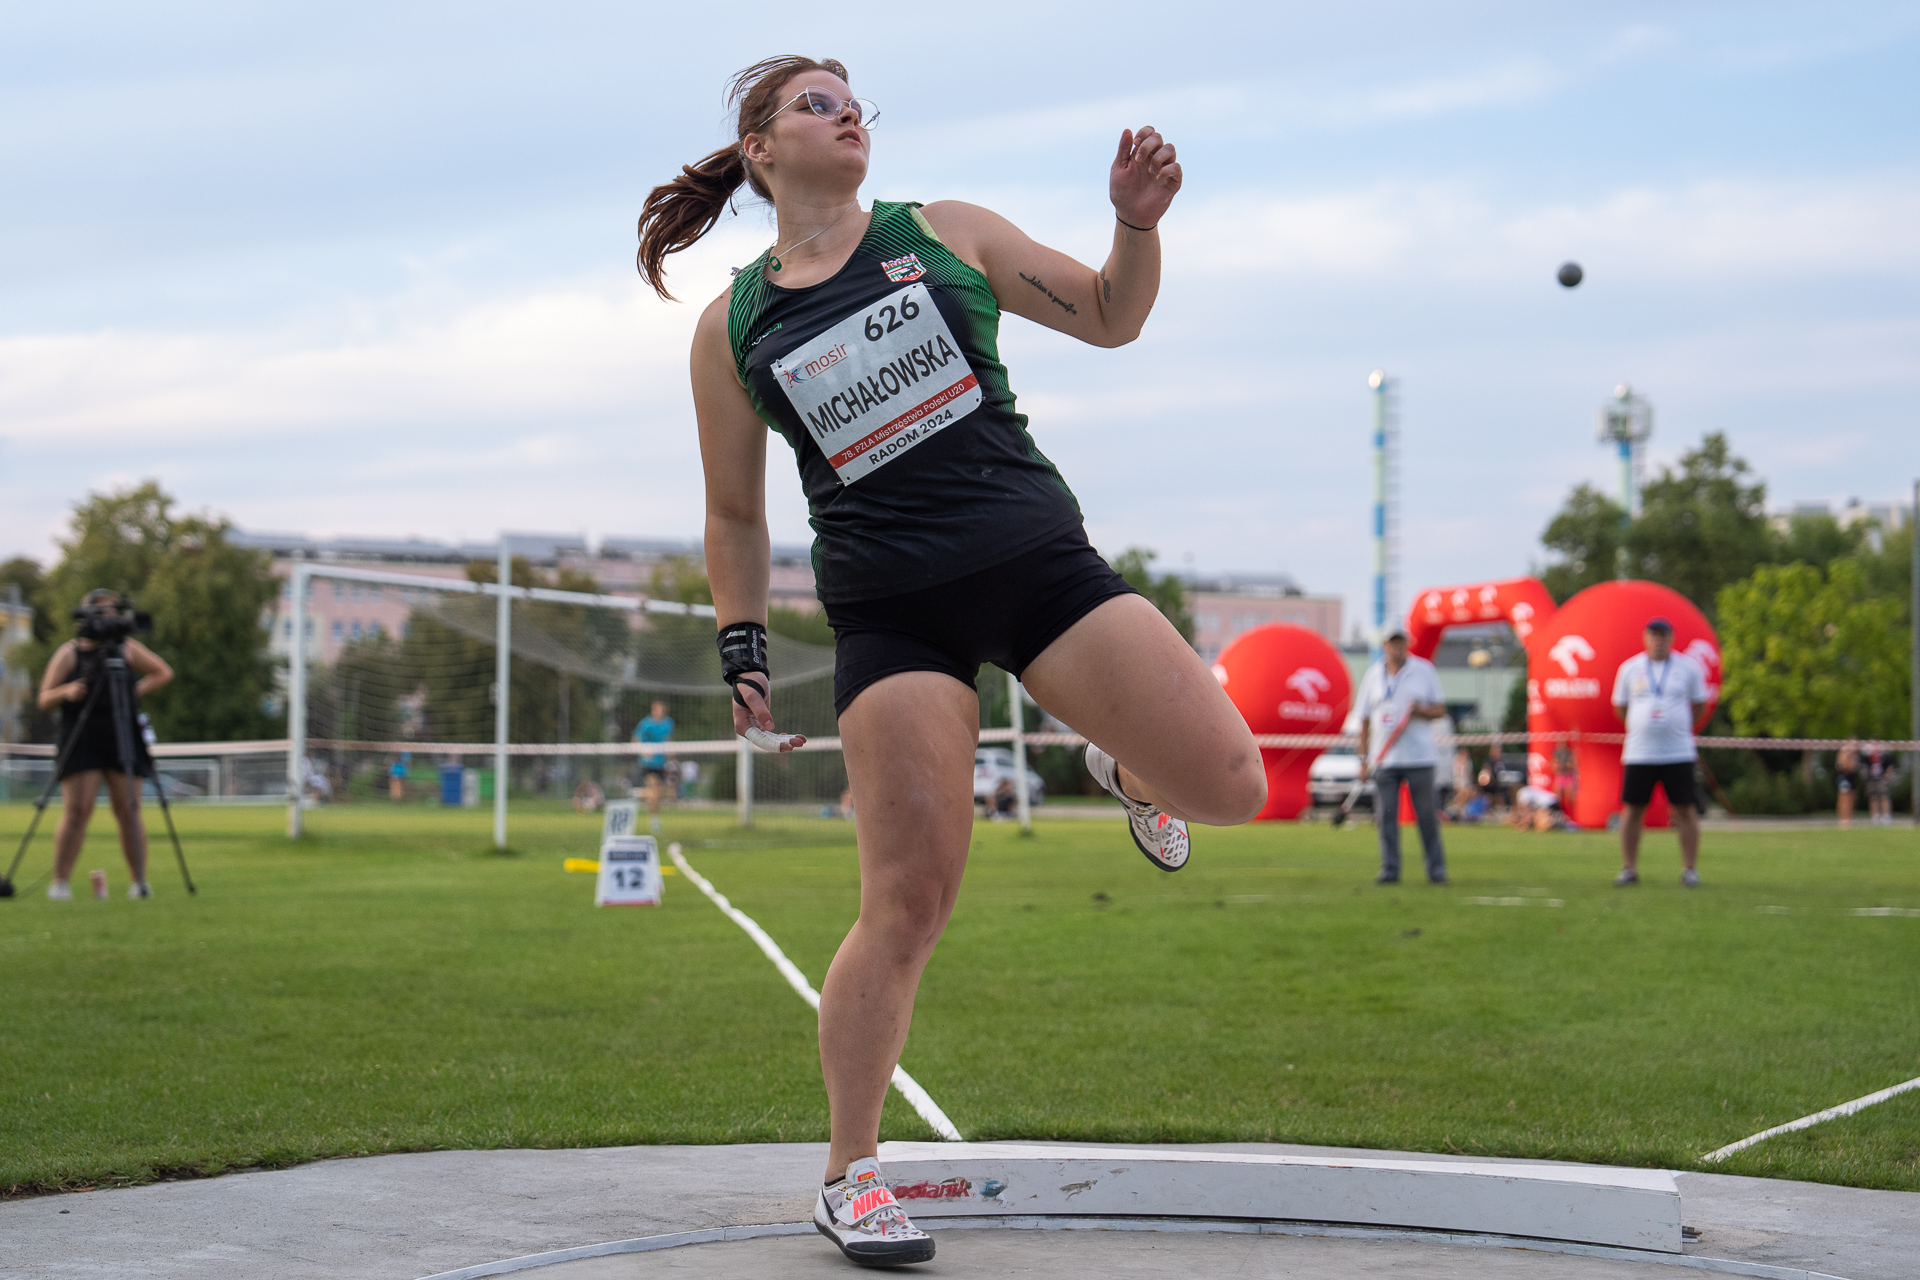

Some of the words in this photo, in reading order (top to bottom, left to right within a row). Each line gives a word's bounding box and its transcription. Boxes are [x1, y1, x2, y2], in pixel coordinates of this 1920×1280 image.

[864, 293, 920, 342] 626
[805, 342, 849, 377] mosir
[806, 334, 959, 439] MICHAŁOWSKA
[841, 449, 856, 461] 78.
[855, 438, 875, 453] PZLA
[875, 409, 924, 442] Mistrzostwa
[923, 394, 949, 412] Polski
[948, 383, 965, 397] U20
[868, 428, 921, 466] RADOM
[919, 408, 954, 434] 2024
[613, 867, 645, 890] 12
[852, 1188, 893, 1220] NIKE
